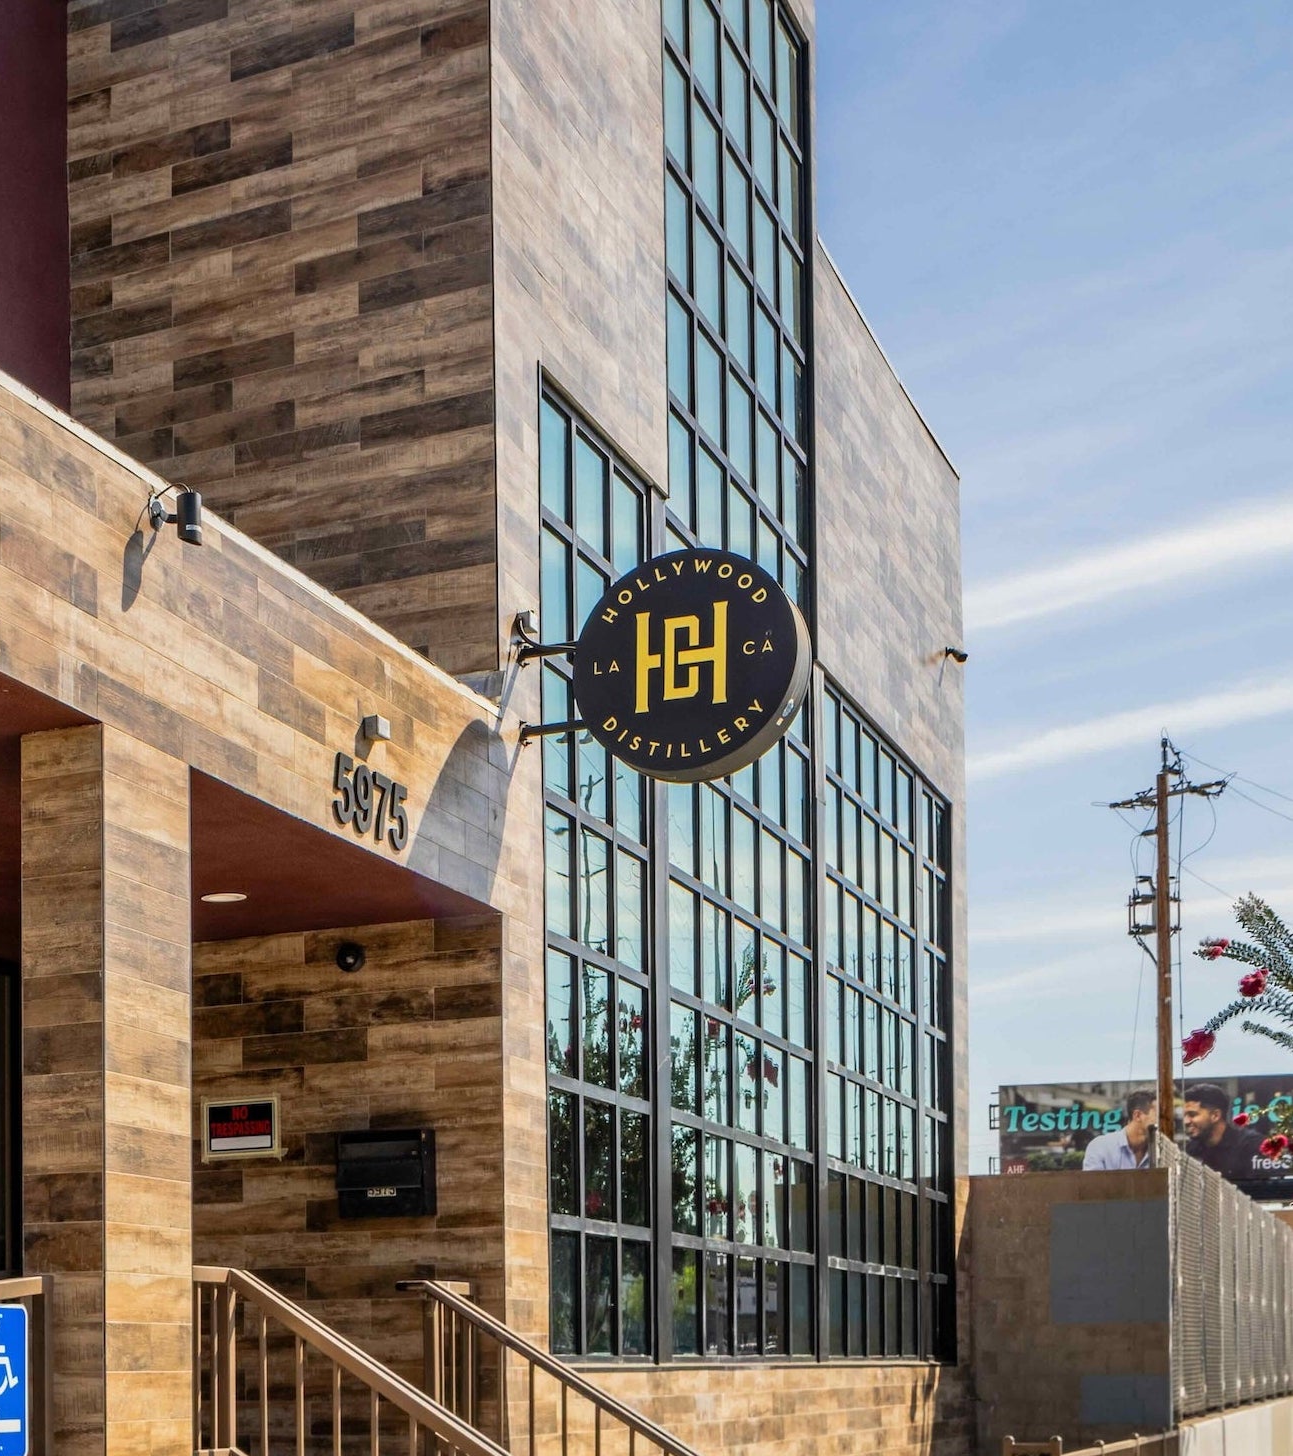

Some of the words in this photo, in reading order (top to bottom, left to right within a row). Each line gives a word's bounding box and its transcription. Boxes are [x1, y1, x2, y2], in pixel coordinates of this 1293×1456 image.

[602, 558, 768, 624] HOLLYWOOD
[742, 639, 774, 655] CA
[593, 660, 620, 675] LA
[602, 699, 764, 758] DISTILLERY
[332, 752, 409, 851] 5975
[232, 1105, 248, 1120] NO
[1003, 1103, 1122, 1135] Testing
[210, 1120, 271, 1137] TRESPASSING
[1006, 1164, 1025, 1175] AHF
